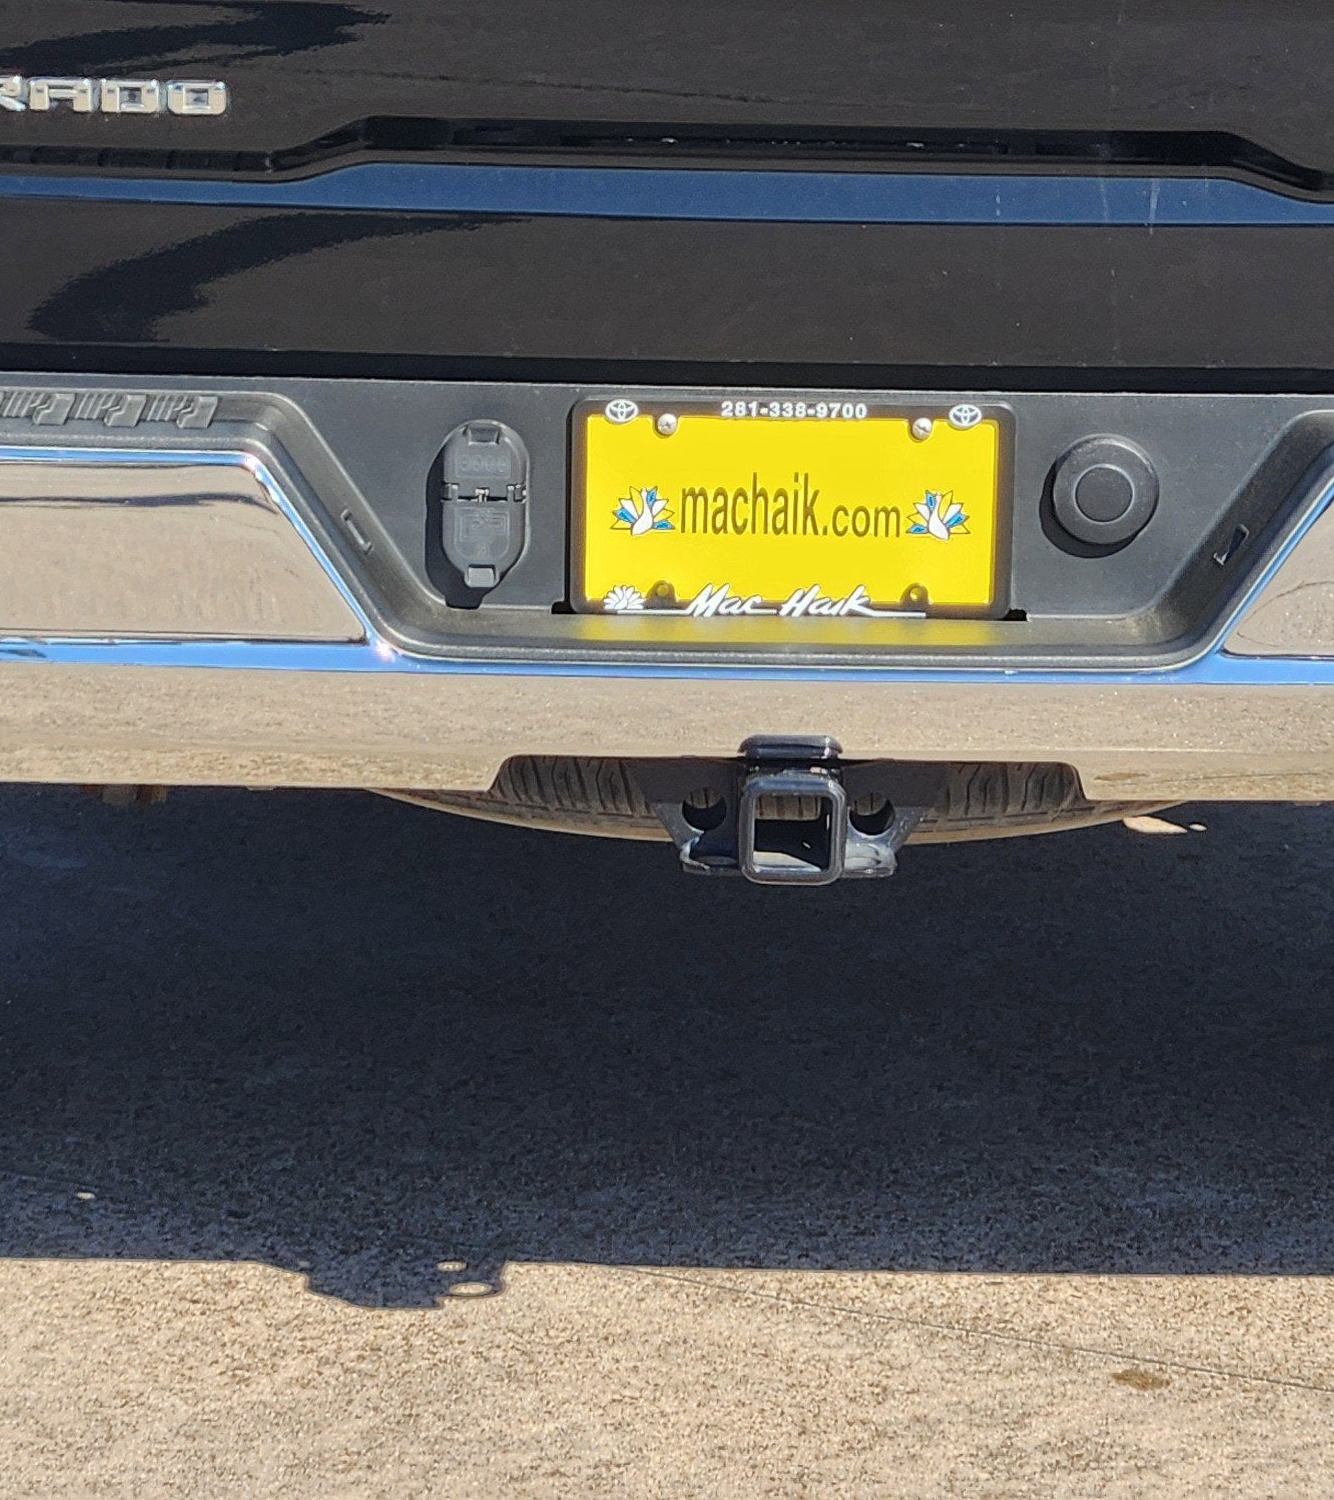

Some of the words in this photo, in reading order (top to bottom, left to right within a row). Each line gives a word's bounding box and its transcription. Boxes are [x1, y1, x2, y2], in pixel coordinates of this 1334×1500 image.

[720, 400, 869, 420] 281-338-9700
[679, 472, 902, 538] machaik.com
[679, 582, 777, 619] Mac
[777, 583, 887, 619] Haik
